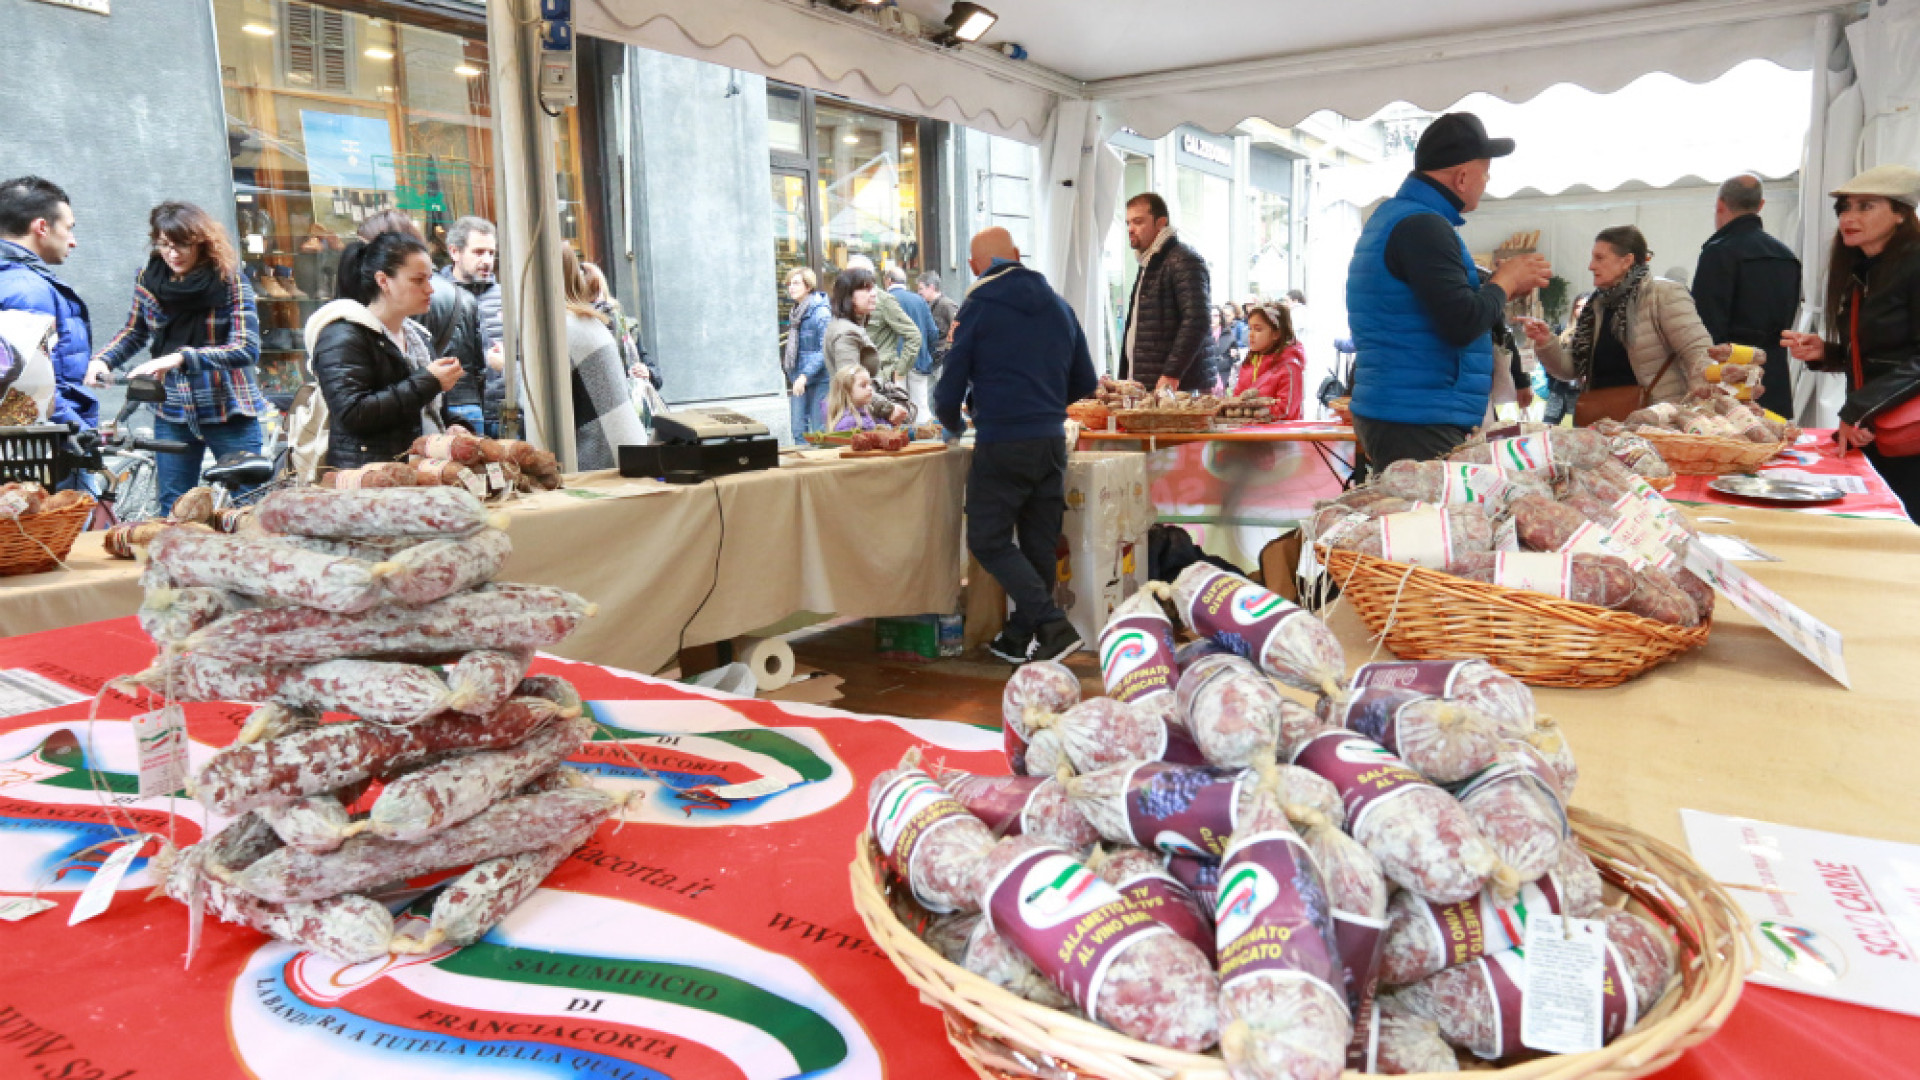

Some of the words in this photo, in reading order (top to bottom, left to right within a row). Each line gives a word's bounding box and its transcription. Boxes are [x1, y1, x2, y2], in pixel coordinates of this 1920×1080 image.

[1058, 902, 1125, 964] SALAMETTO
[1077, 945, 1096, 968] AL
[1090, 919, 1124, 945] VINO
[1443, 908, 1465, 942] VINO
[507, 957, 719, 1001] SALUMIFICIO
[565, 996, 606, 1013] DI
[350, 1029, 367, 1042] A
[370, 1031, 467, 1055] TUTELA
[477, 1044, 562, 1064] DELLA
[571, 1056, 650, 1080] QUAL
[417, 1008, 679, 1060] FRANCIACORTA
